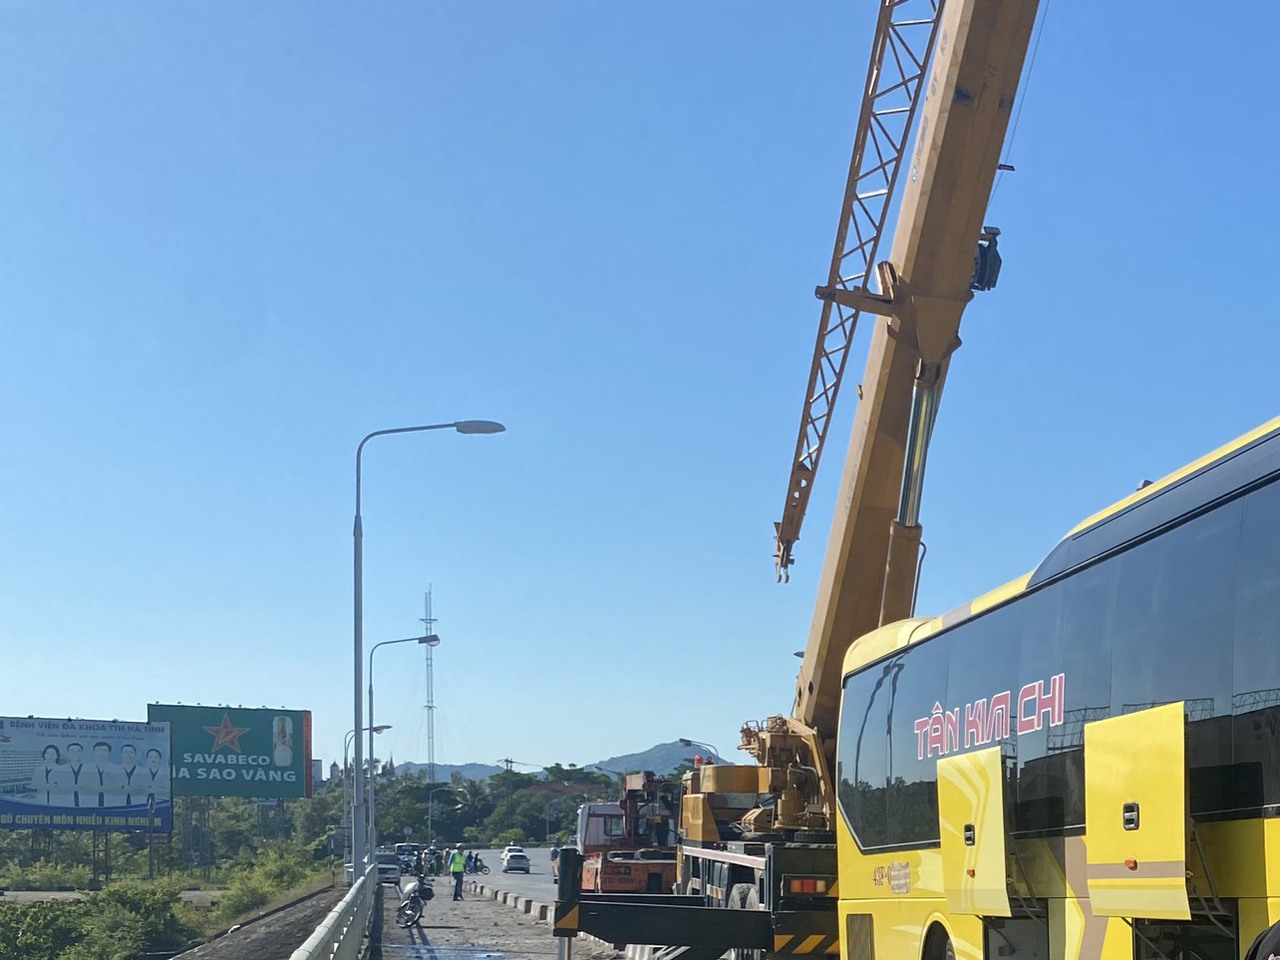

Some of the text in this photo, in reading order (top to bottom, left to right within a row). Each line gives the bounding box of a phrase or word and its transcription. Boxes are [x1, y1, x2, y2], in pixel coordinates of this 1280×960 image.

[914, 672, 1066, 760] TÂN KIM CHI
[183, 752, 270, 766] SAVABECO
[172, 764, 296, 782] IA SAO VÀNG
